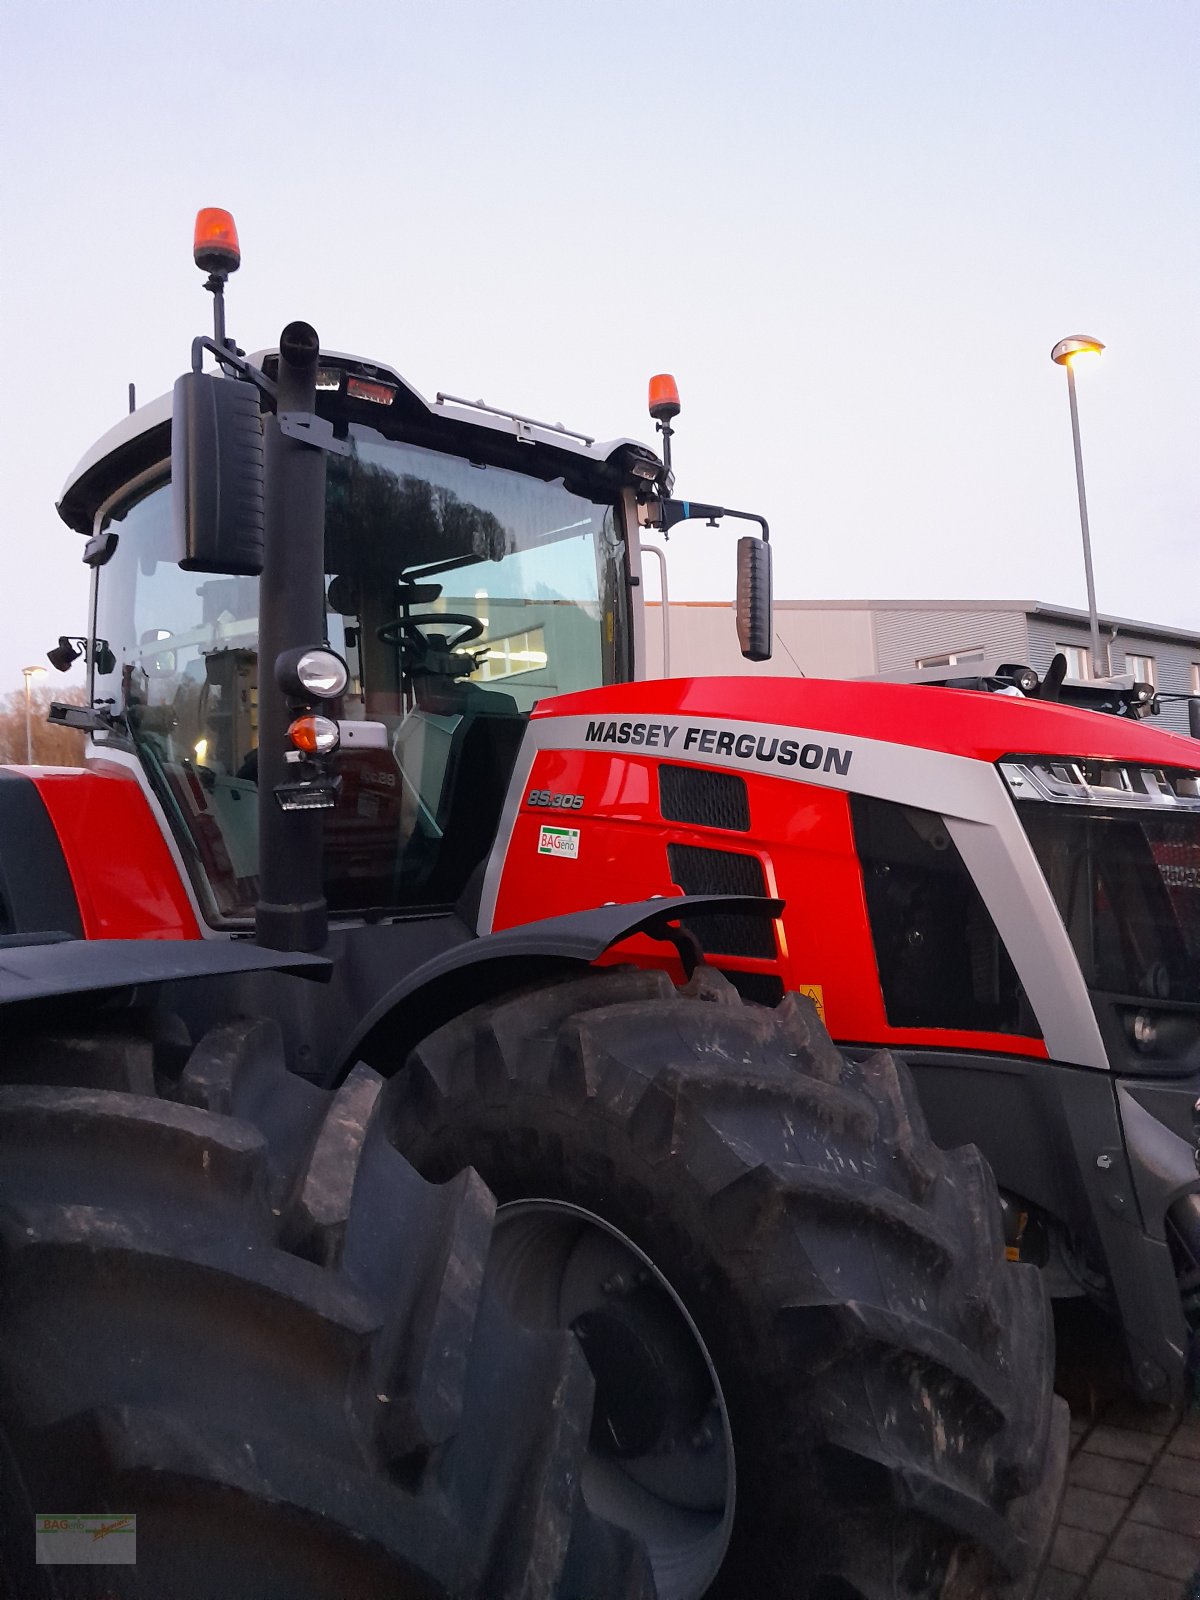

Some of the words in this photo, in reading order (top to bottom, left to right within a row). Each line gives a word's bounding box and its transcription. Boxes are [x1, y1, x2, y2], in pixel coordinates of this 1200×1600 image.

[585, 721, 679, 748] MASSEY
[683, 728, 853, 776] FERGUSON
[541, 833, 575, 851] BAGeno
